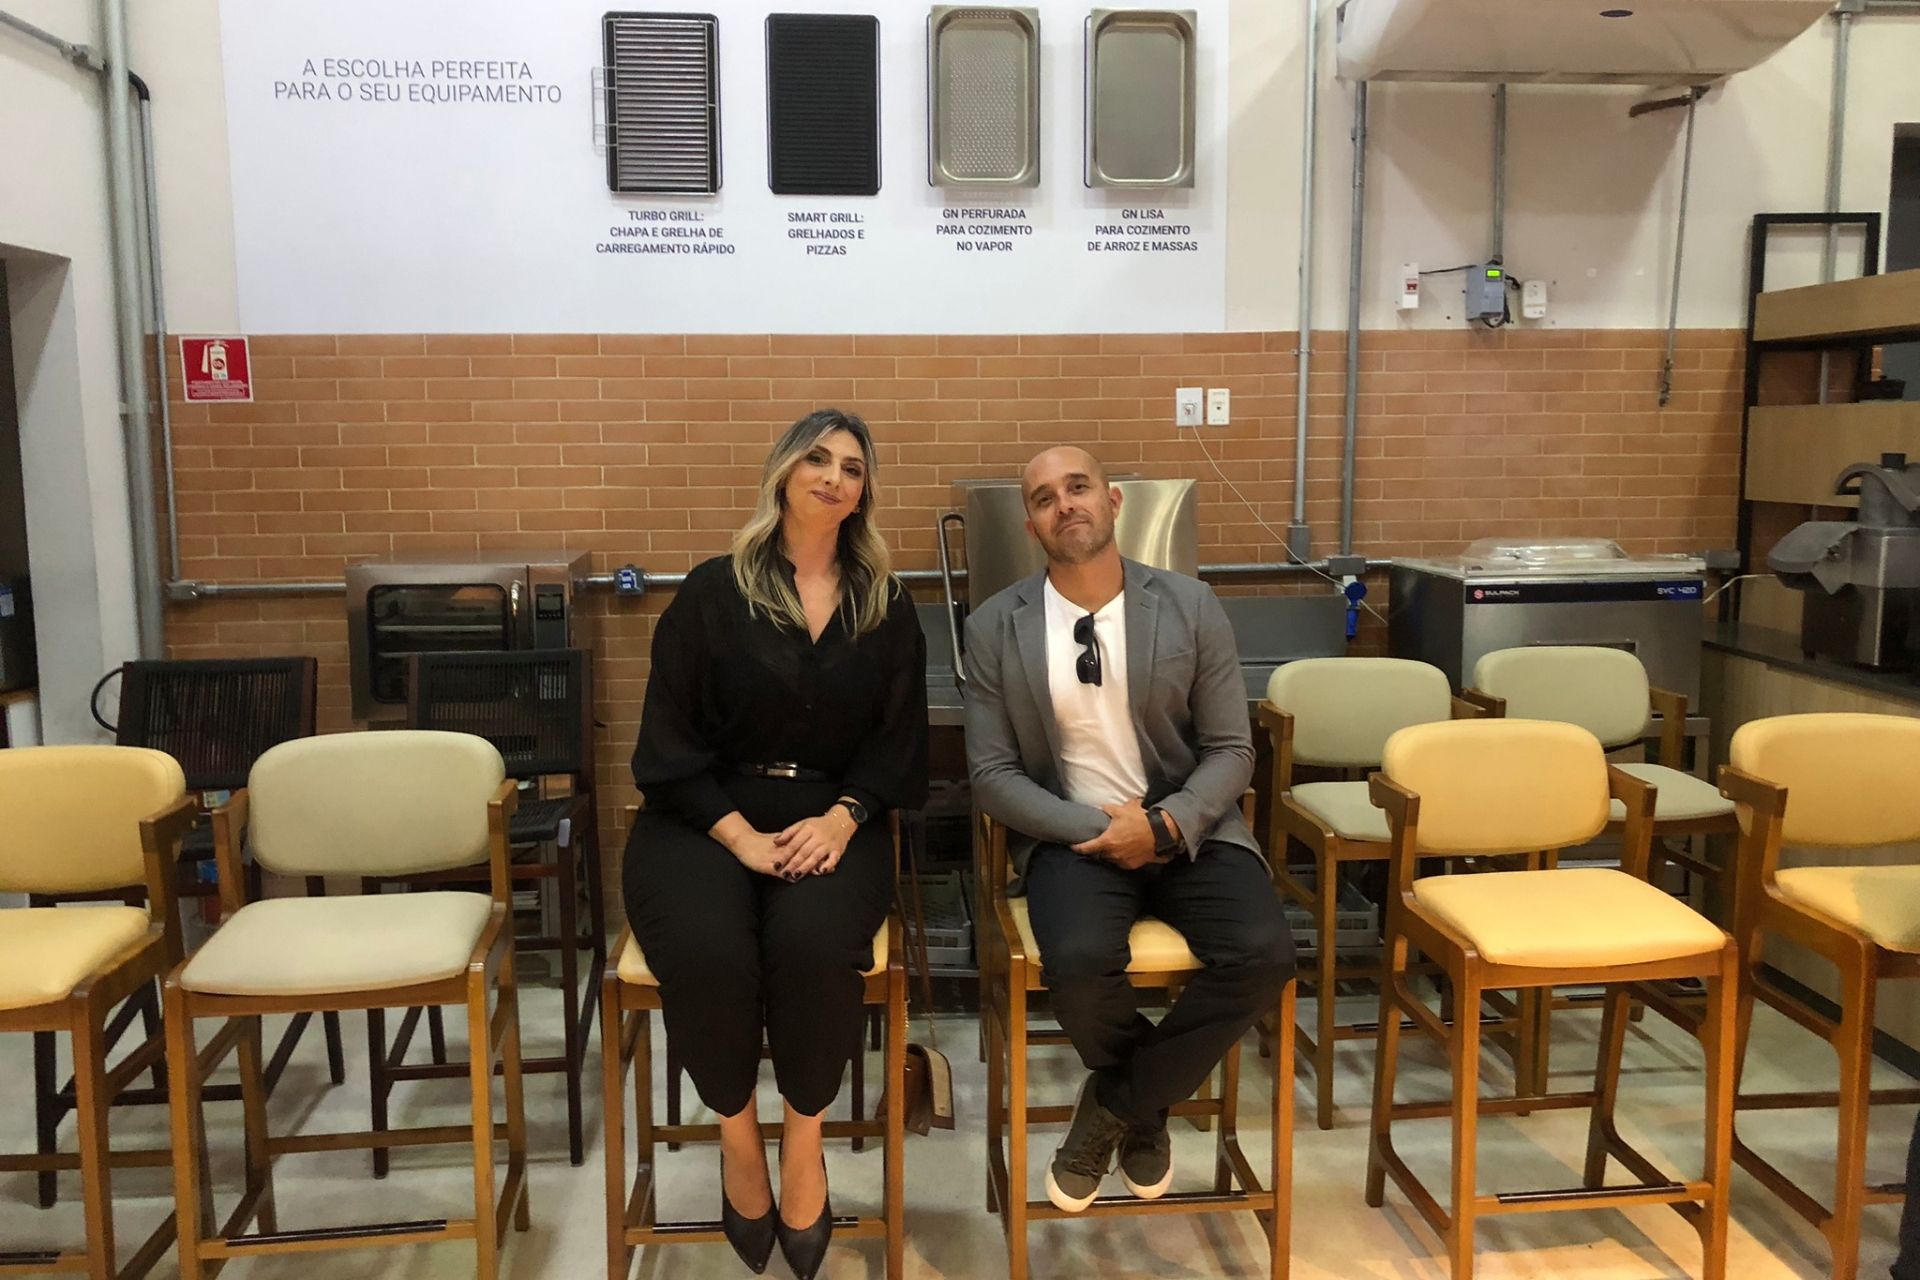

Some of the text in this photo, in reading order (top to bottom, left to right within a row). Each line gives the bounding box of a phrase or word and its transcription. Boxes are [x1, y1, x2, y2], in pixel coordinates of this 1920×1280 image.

[303, 59, 532, 79] A ESCOLHA PERFEITA
[274, 82, 561, 104] PARA O SEU EQUIPAMENTO
[628, 210, 705, 222] TURBO GRILL:
[788, 211, 864, 223] SMART GRILL:
[943, 208, 1027, 219] GN PERFURADA
[1122, 208, 1165, 220] GN LISA
[610, 226, 724, 239] CHAPA E GRELHA DE
[788, 228, 865, 240] GRELHADOS E
[937, 224, 1033, 236] PARA COZIMENTO
[1096, 224, 1191, 236] PARA COZIMENTO
[596, 241, 736, 255] CARREGAMENTO RÁPIDO
[807, 245, 847, 256] PIZZAS
[957, 241, 1013, 252] NO VAPOR
[1088, 241, 1199, 252] DE ARROZ E MASSAS
